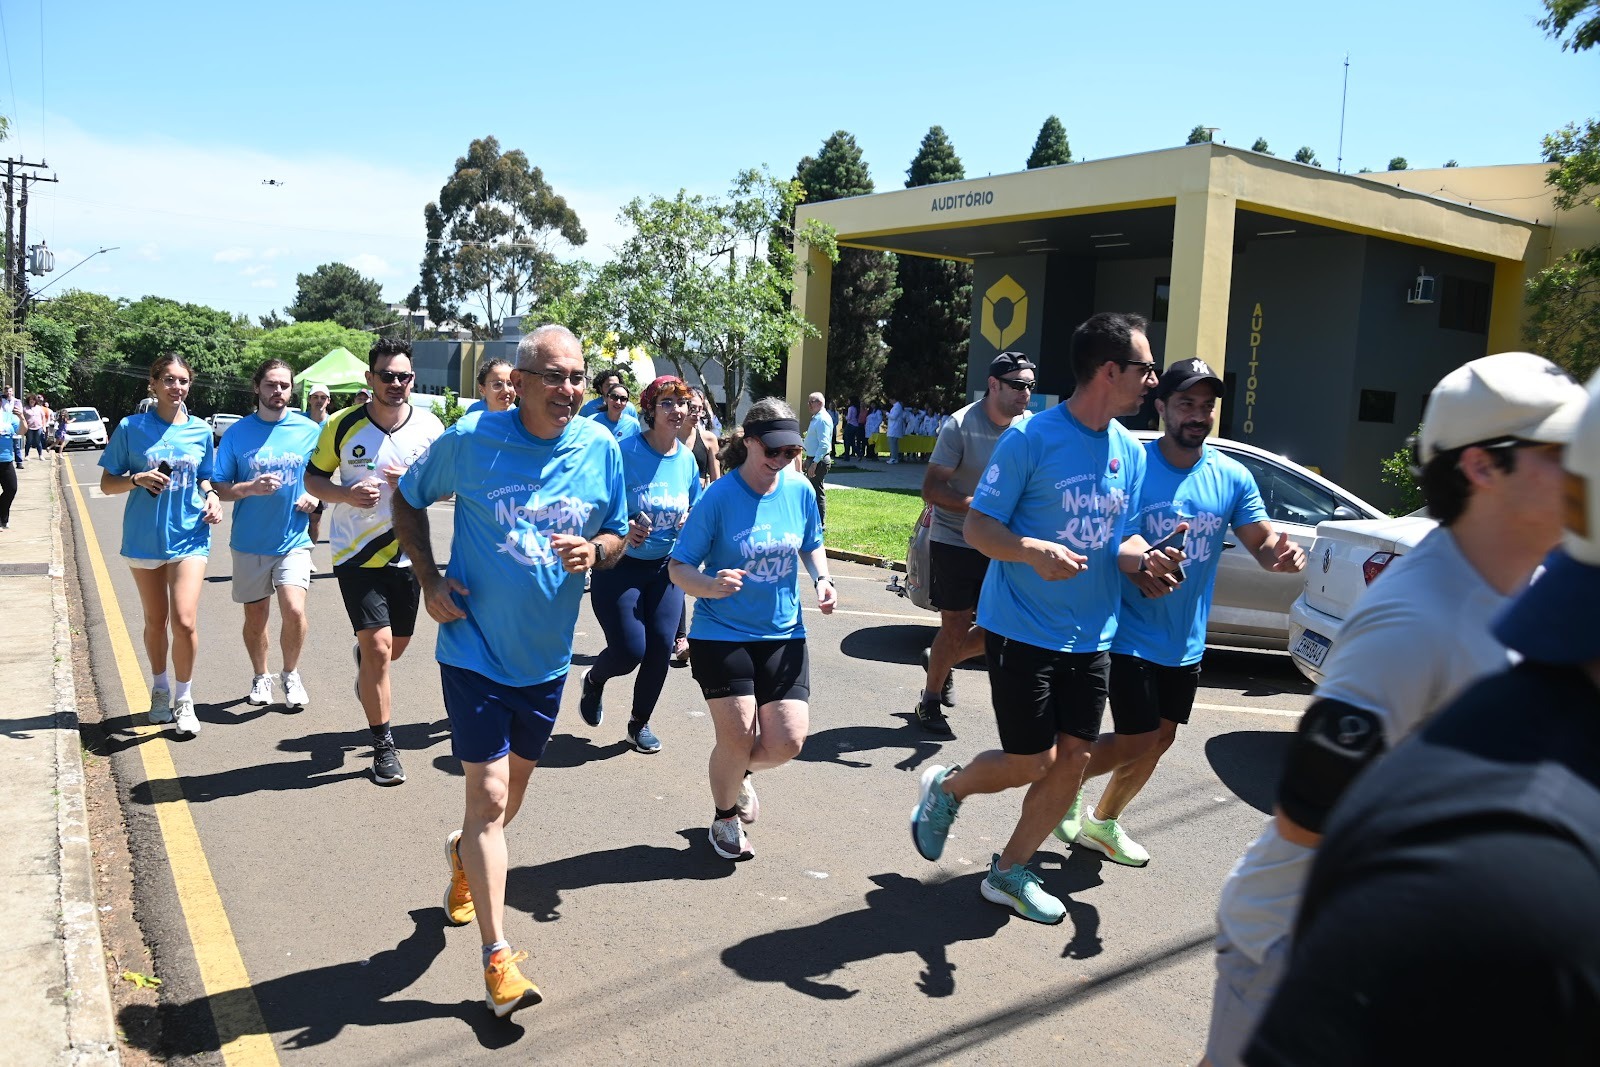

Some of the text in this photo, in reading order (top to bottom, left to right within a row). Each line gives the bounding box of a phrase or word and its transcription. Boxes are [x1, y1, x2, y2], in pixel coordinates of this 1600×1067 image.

[931, 191, 994, 211] AUDITÓRIO
[1243, 302, 1263, 434] AUDITÓRIO
[247, 451, 304, 471] NOVEMBRO
[486, 483, 541, 500] CORRIDA DO
[633, 482, 659, 493] CORRIDA
[1055, 475, 1087, 490] CORRIDA
[1062, 483, 1131, 517] NOVEMBRO
[1172, 499, 1184, 507] DO
[494, 493, 594, 530] NOVEMBRO
[732, 523, 772, 542] CORRIDA DO
[739, 531, 802, 560] NOVEMBRO
